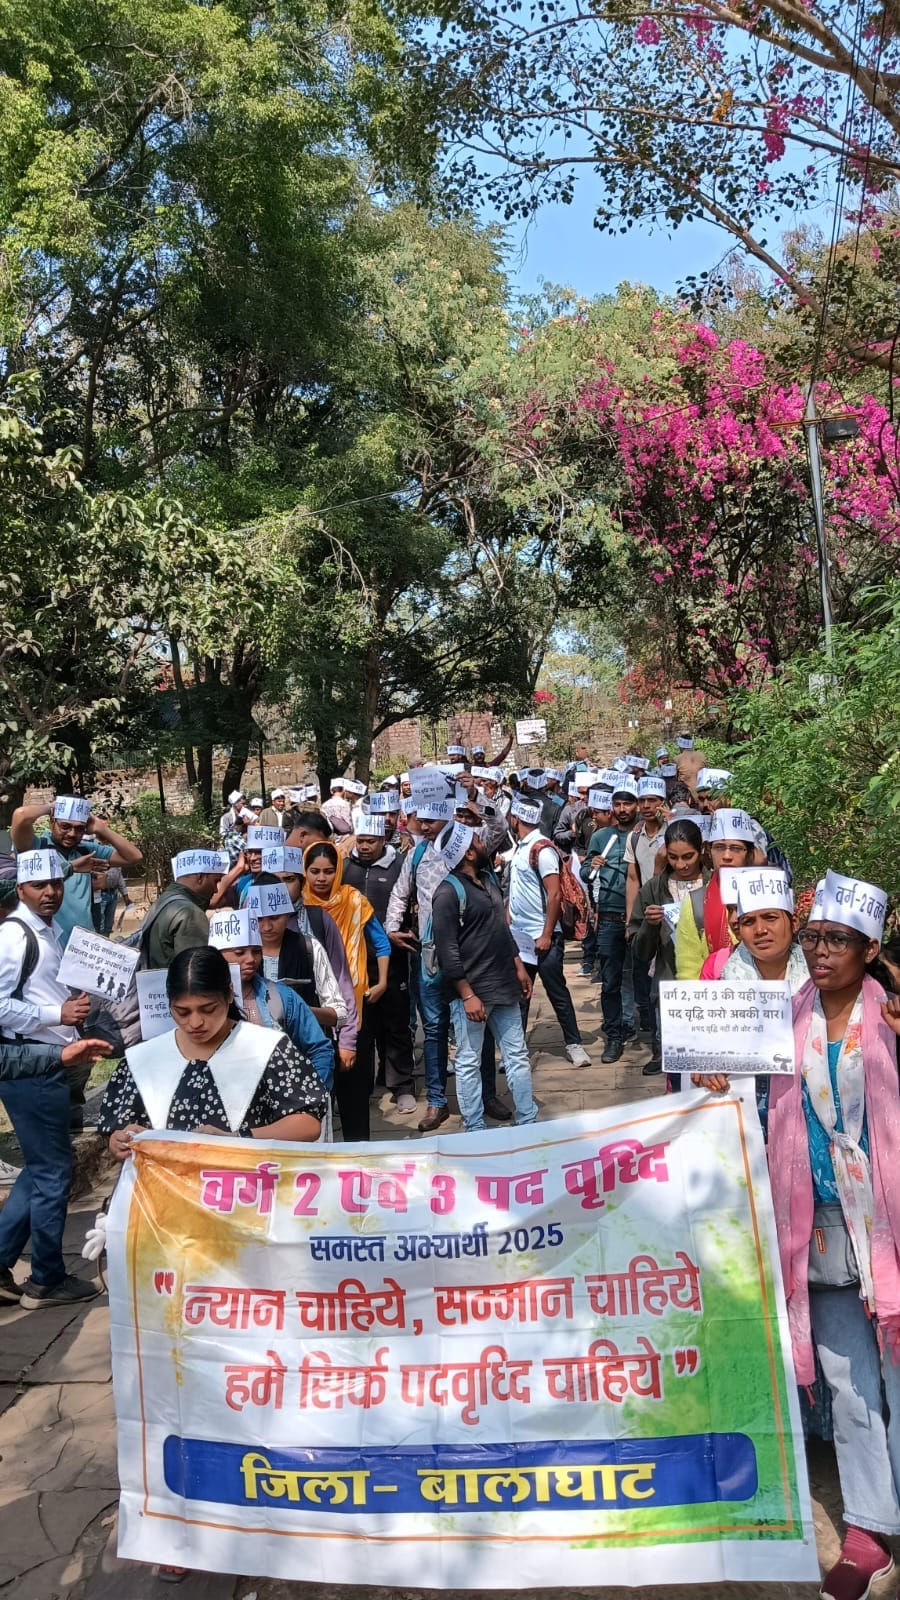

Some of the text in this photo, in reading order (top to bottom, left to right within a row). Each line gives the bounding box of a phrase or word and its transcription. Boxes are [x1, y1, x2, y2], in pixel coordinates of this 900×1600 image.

[215, 922, 223, 936] पद
[224, 914, 240, 942] वृद्धि
[664, 988, 788, 1004] वर्ग 2, वर्ग 3 की यही पुकार,
[668, 1010, 682, 1019] पद
[685, 1006, 704, 1021] वृद्धि
[707, 1006, 726, 1019] करो
[730, 1006, 760, 1019] अबकी
[202, 1162, 279, 1213] वर्ग
[294, 1172, 321, 1216] 2
[338, 1160, 416, 1213] एवं
[430, 1174, 456, 1215] 3
[475, 1169, 548, 1211] पद
[310, 1222, 564, 1262] समस्त अभ्यार्थी 2025
[185, 1286, 286, 1330] न्यान
[434, 1277, 574, 1326] सम्मान
[584, 1251, 702, 1316] चाहिये
[224, 1350, 288, 1412] हमे
[299, 1346, 390, 1409] सिर्फ
[542, 1336, 661, 1403] चाहिये
[417, 1463, 656, 1504] बालाघाट
